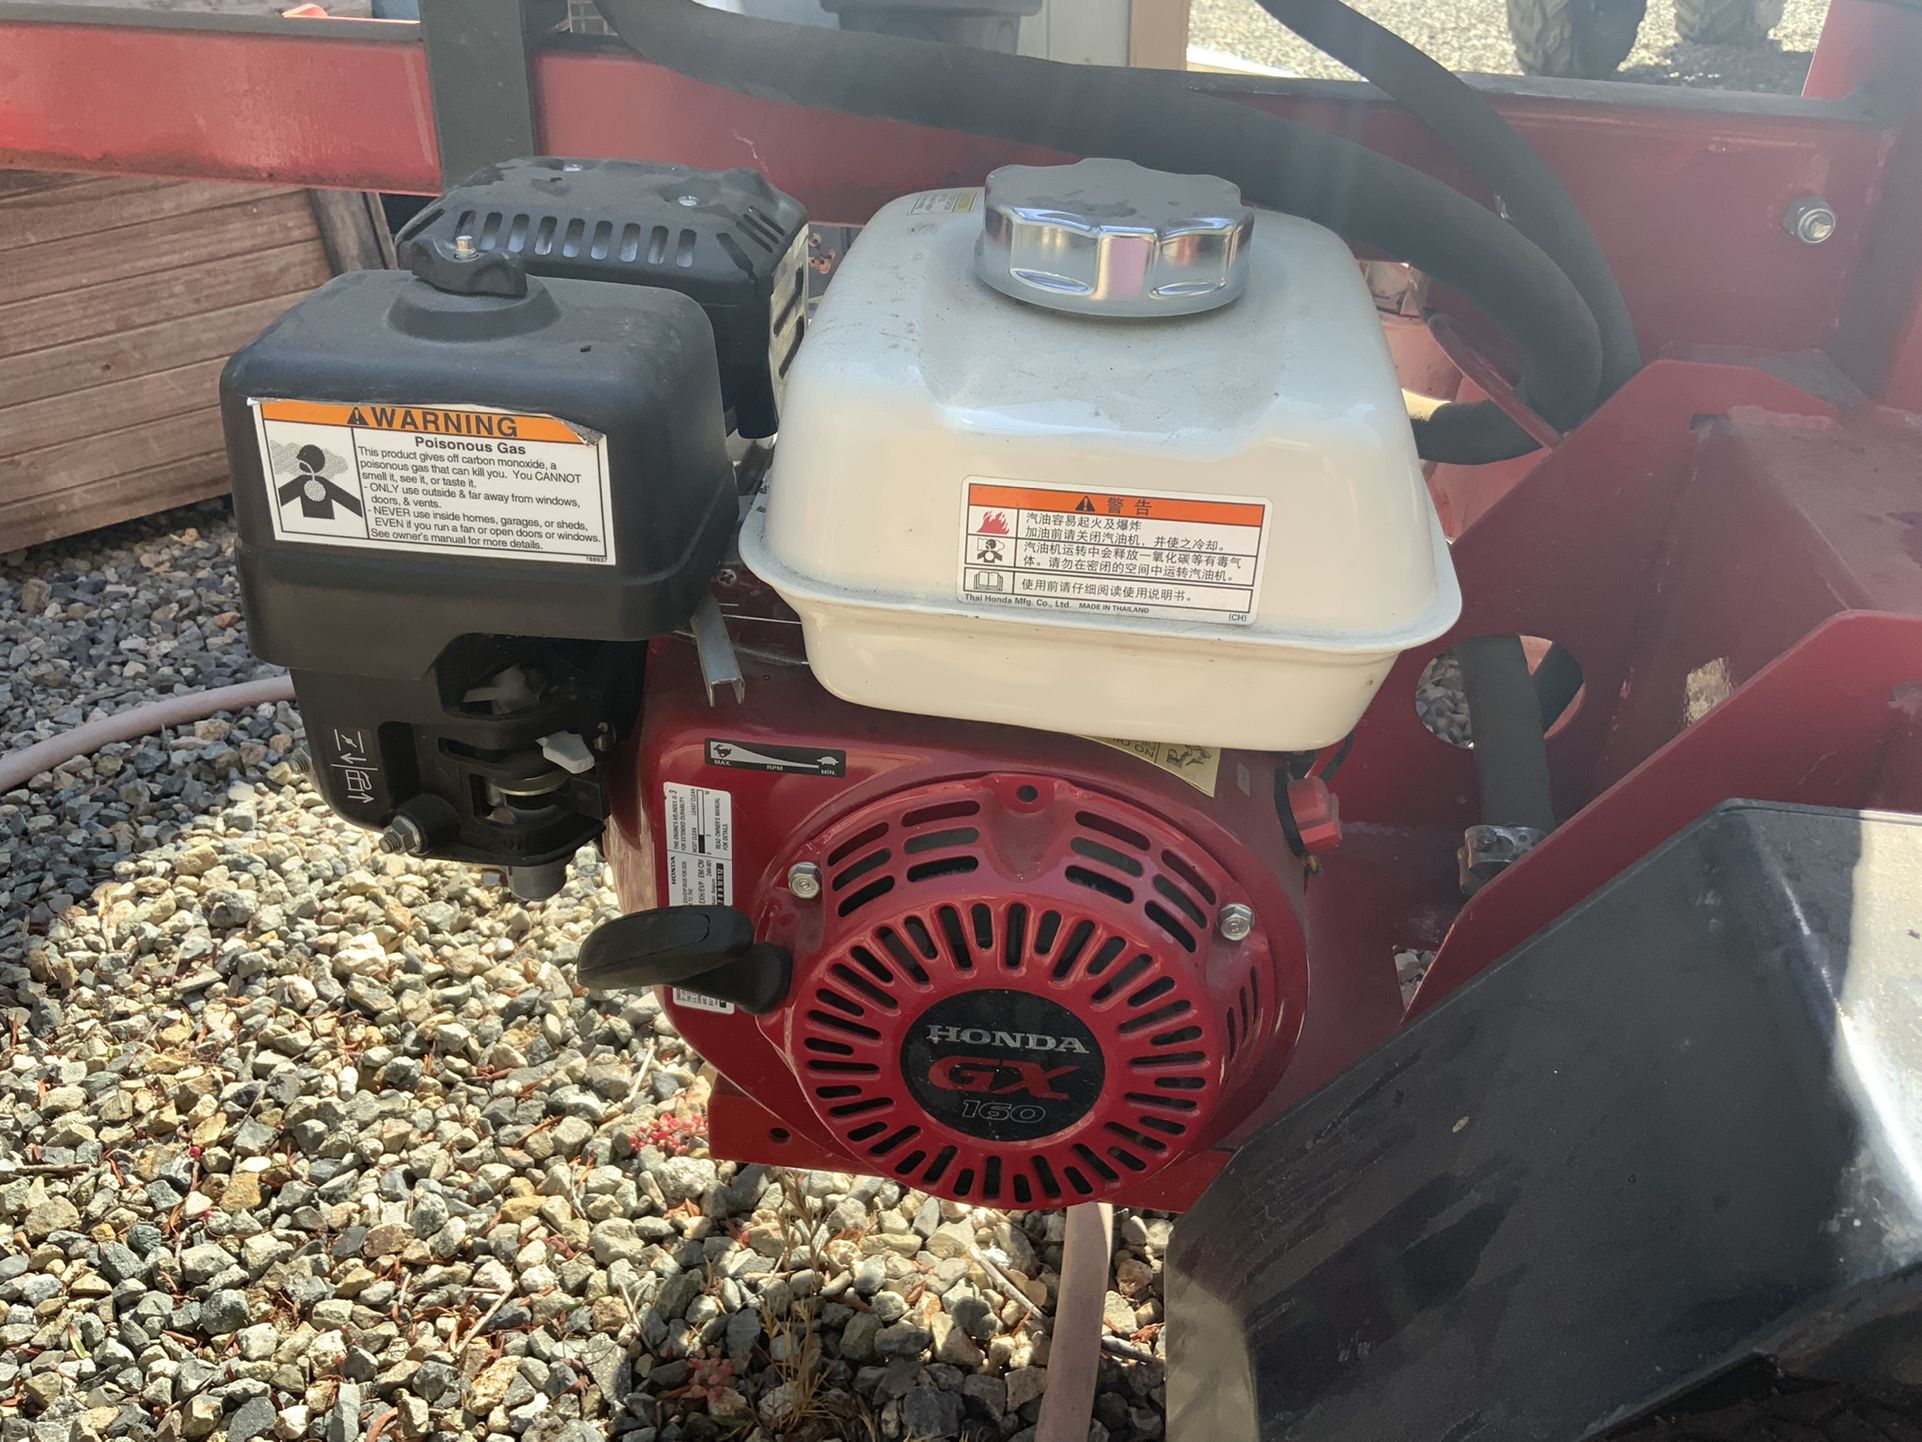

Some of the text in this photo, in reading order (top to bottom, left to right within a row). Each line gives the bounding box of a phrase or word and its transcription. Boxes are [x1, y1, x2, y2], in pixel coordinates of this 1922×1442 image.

[370, 408, 517, 437] WARNING
[414, 435, 526, 455] Poisonous Gas
[357, 445, 557, 471] This product gives off carbon monoxide, a
[359, 459, 581, 483] poisonous gas that can kill you. You CANNOT
[361, 471, 476, 488] smell it, see it, or taste it.
[369, 482, 399, 493] ONLY
[401, 487, 420, 495] use
[421, 487, 456, 498] outside
[458, 489, 466, 499] &
[468, 489, 482, 500] far
[483, 493, 509, 504] away
[511, 493, 534, 503] from
[535, 495, 580, 508] windows,
[370, 494, 441, 508] doors, & vents.
[373, 505, 411, 517] NEVER
[412, 510, 430, 519] use
[432, 510, 460, 521] inside
[462, 512, 498, 525] homes,
[500, 517, 542, 528] garages,
[544, 520, 555, 528] or
[556, 519, 588, 531] sheds,
[374, 516, 404, 528] EVEN
[406, 519, 412, 528] if
[413, 522, 432, 531] you
[433, 523, 450, 531] run
[459, 523, 476, 533] fan
[477, 526, 488, 534] or
[489, 527, 514, 537] open
[515, 528, 543, 538] doors
[556, 531, 601, 542] windows.
[370, 527, 543, 550] See owner's manual for more details.
[965, 593, 982, 601] Thai
[984, 594, 1012, 604] Honda
[1112, 604, 1149, 614] THAILAND
[1227, 613, 1247, 623] (CH)
[926, 1024, 1090, 1054] HONDA
[928, 1056, 1080, 1101] GX
[962, 1100, 1046, 1123] 160
